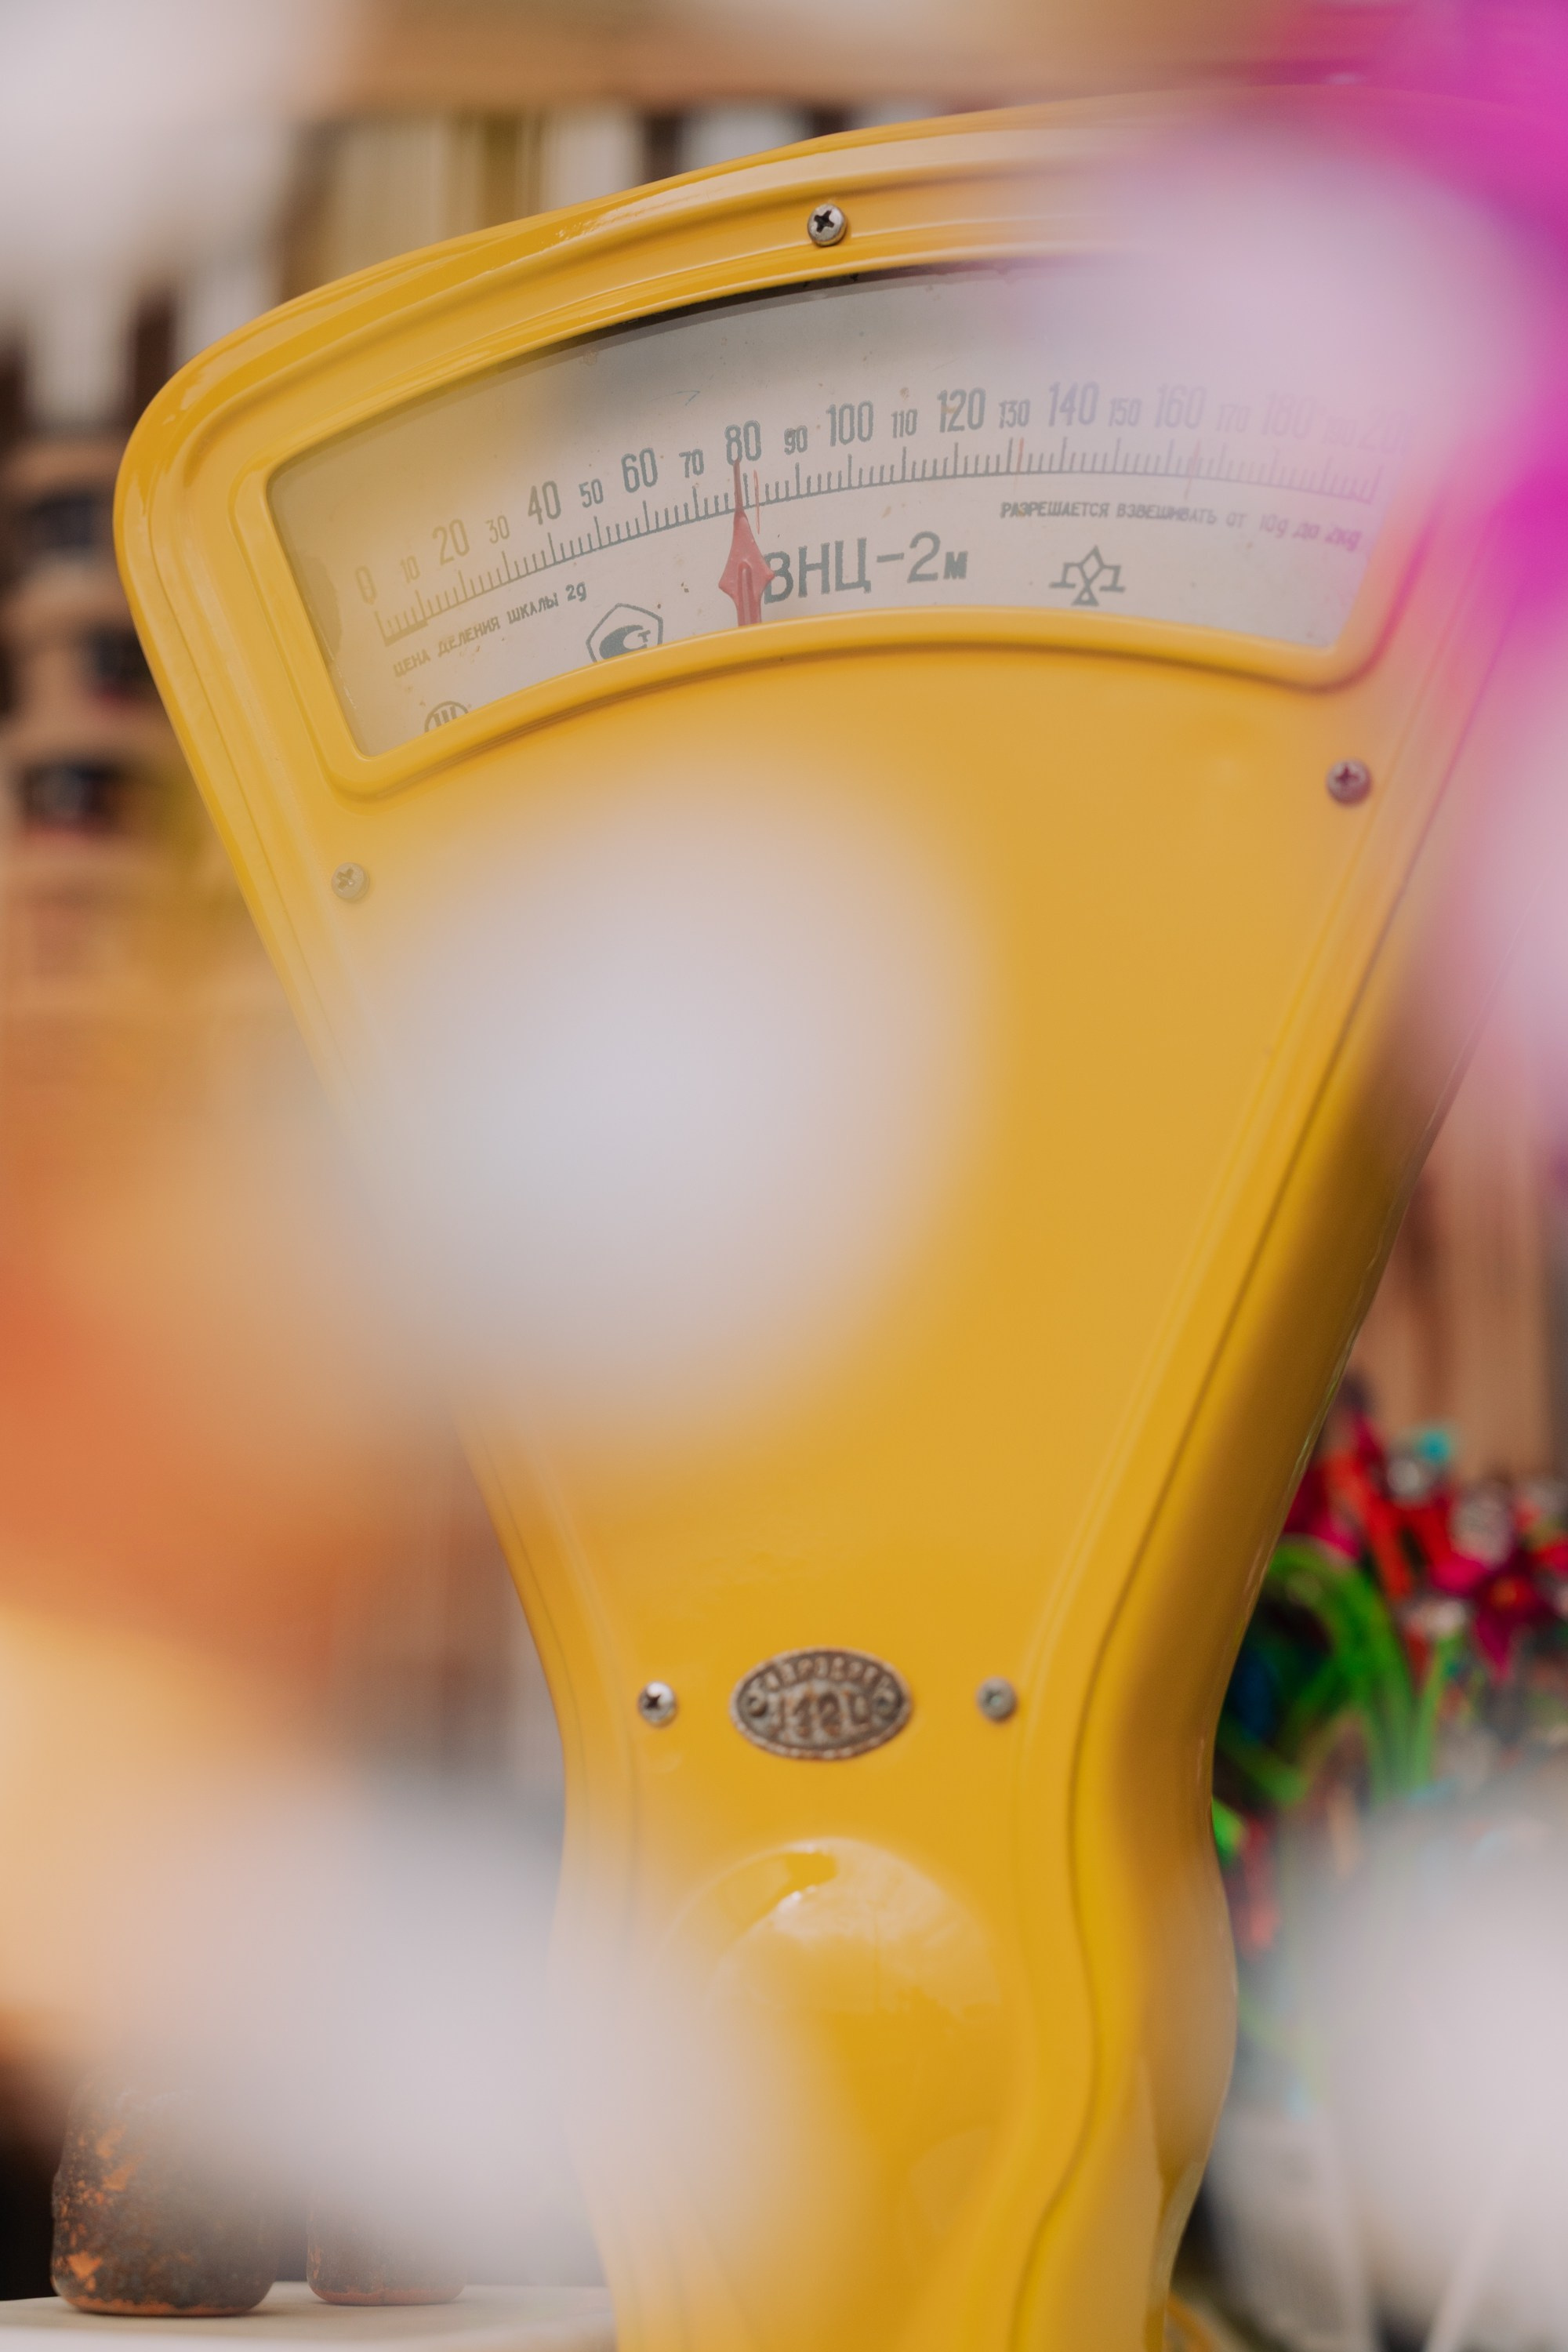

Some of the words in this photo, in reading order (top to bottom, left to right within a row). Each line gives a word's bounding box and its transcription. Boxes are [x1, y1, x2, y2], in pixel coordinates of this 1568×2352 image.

[354, 564, 378, 605] 0
[400, 554, 420, 584] 10
[431, 517, 470, 567] 20
[485, 514, 510, 544] 30
[527, 480, 562, 525] 40
[579, 478, 604, 508] 50
[621, 447, 659, 493] 60
[679, 448, 705, 478] 70
[724, 419, 762, 466] 80
[783, 425, 808, 456] 90
[826, 400, 874, 448] 100
[891, 408, 918, 439] 110
[937, 387, 987, 434] 120
[998, 398, 1031, 430] 130
[1047, 380, 1099, 426] 140
[1108, 397, 1143, 428] 150
[1153, 383, 1208, 430] 160
[1214, 401, 1250, 434] 170
[1000, 501, 1110, 519] РАЗРЕШАЕТСЯ
[1116, 503, 1218, 525] ВЗВЕШИВАТЬ
[393, 648, 431, 678] ЦЕНА
[437, 615, 501, 657] ДЕЛЕНИЯ
[506, 592, 559, 624] ШКАЛЫ
[564, 582, 587, 602] 2g
